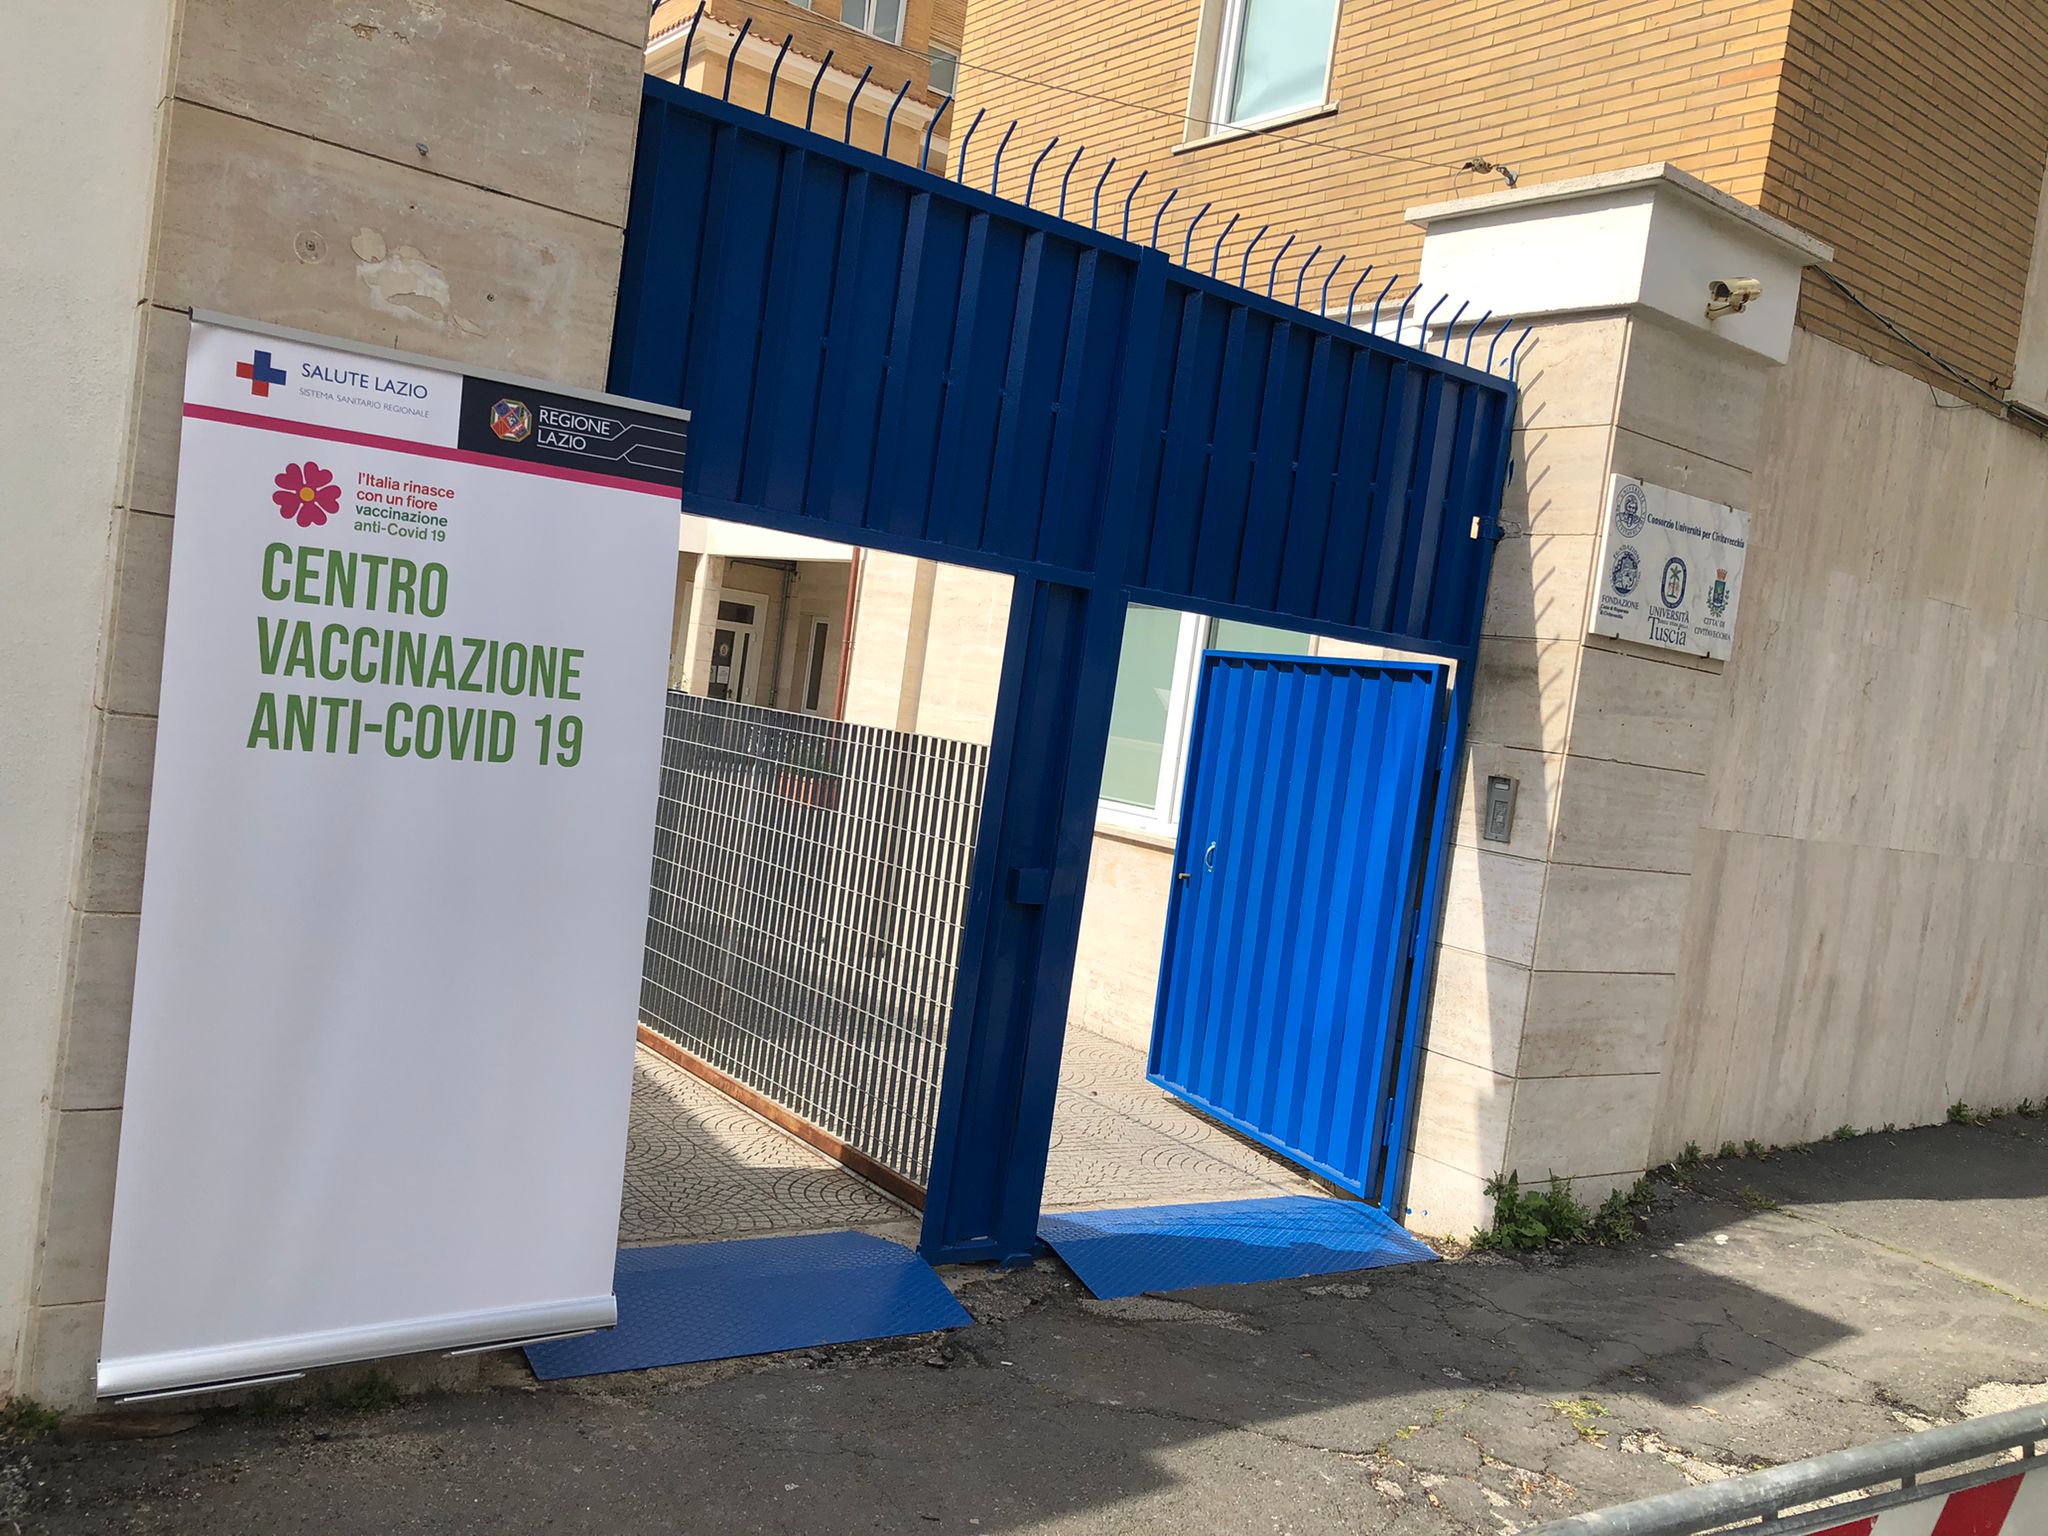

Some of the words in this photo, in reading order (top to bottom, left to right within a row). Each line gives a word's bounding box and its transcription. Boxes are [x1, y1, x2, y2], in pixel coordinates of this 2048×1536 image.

[301, 361, 370, 389] SALUTE
[373, 377, 429, 400] LAZIO
[298, 387, 336, 402] SISTEMA
[335, 393, 382, 408] SANITARIO
[381, 401, 431, 418] REGIONALE
[538, 407, 611, 436] REGIONE
[536, 427, 588, 451] LAZIO
[356, 490, 384, 504] con
[385, 493, 404, 506] un
[405, 494, 439, 512] fiore
[402, 479, 456, 499] rinasce
[355, 504, 448, 527] vaccinazione
[353, 519, 428, 541] anti-Covid
[430, 529, 446, 543] 19
[1647, 512, 1675, 531] Consorzio
[1674, 521, 1702, 537] Università
[1701, 529, 1712, 541] per
[1711, 530, 1745, 549] Civitavecchia
[261, 541, 450, 618] CENTRO
[1601, 594, 1640, 610] FONDAZIONE
[1649, 605, 1690, 624] UNIVERSITÀ
[1647, 615, 1687, 646] Tuscia
[256, 616, 585, 701] VACCINAZIONE
[246, 691, 517, 763] ANTI-COVID
[533, 713, 585, 769] 19
